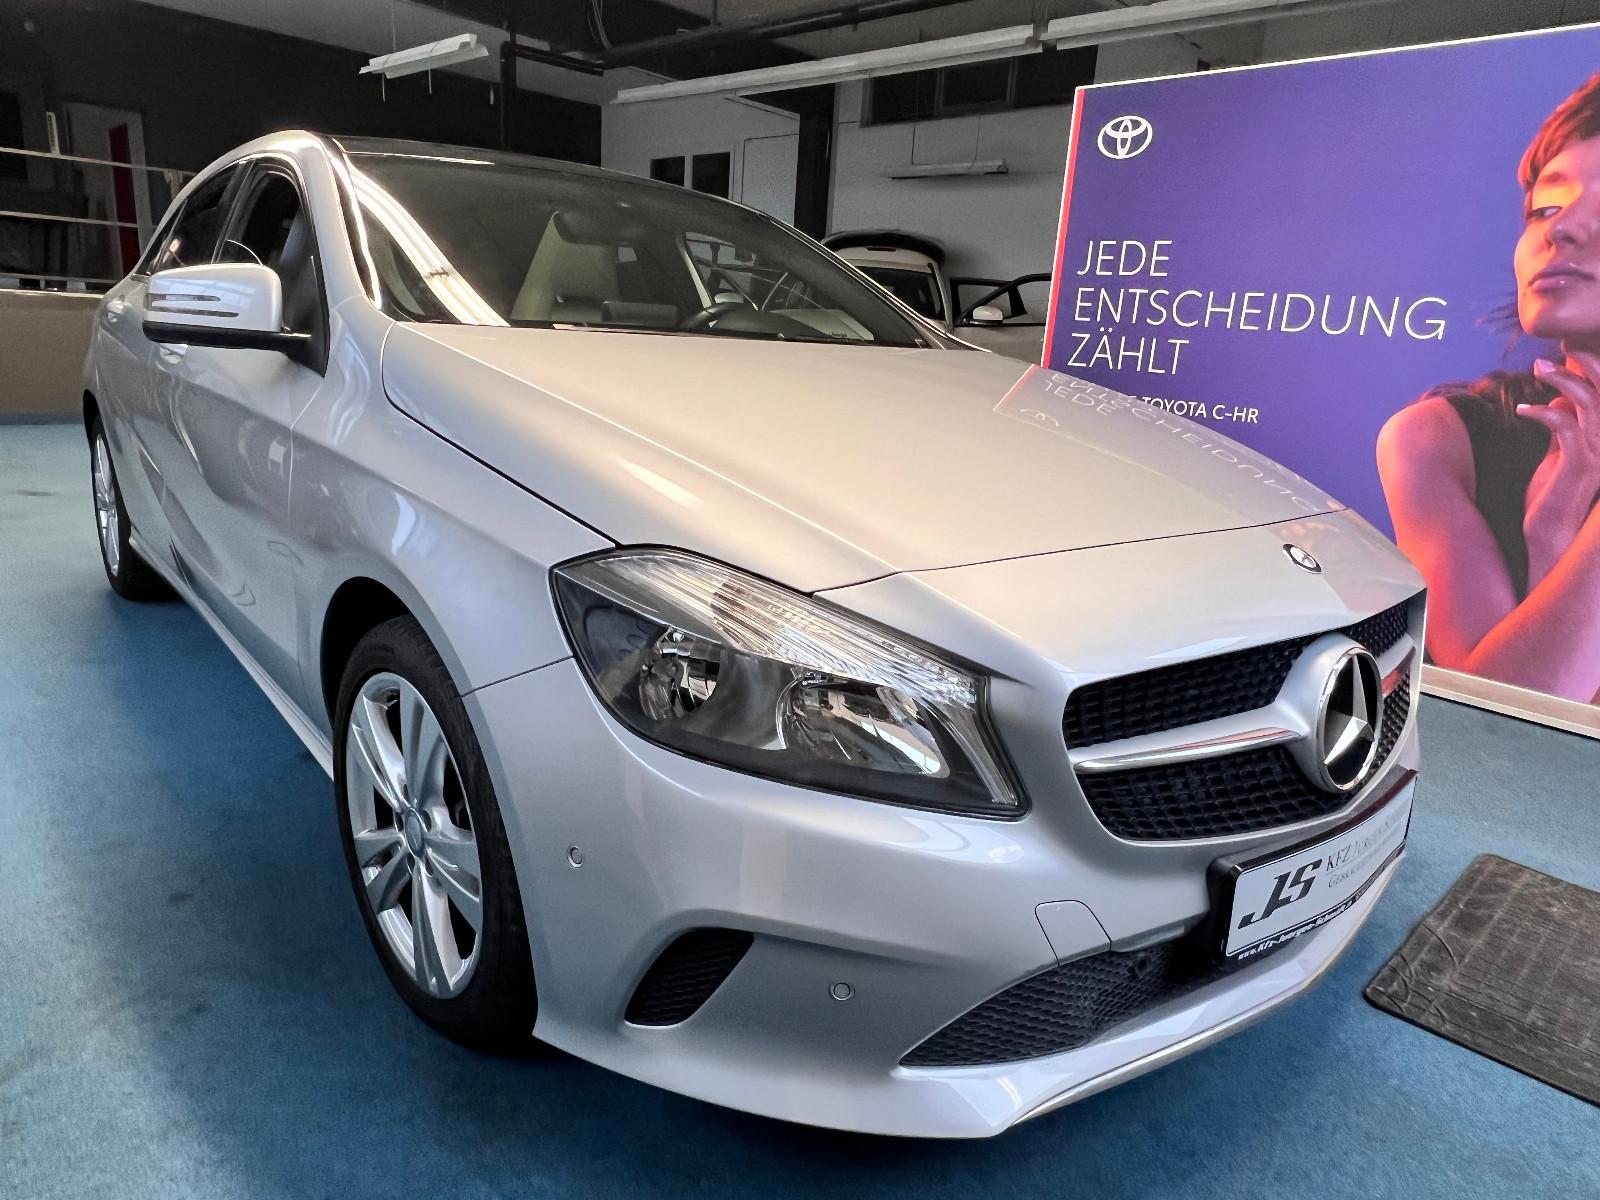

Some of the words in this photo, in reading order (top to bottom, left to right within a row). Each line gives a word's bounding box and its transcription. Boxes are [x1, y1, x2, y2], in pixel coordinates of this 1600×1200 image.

[1077, 240, 1173, 277] JEDE
[1074, 287, 1448, 340] ENTSCHEIDUNG
[1067, 327, 1190, 376] ZÄHLT
[1212, 404, 1259, 424] C-HR
